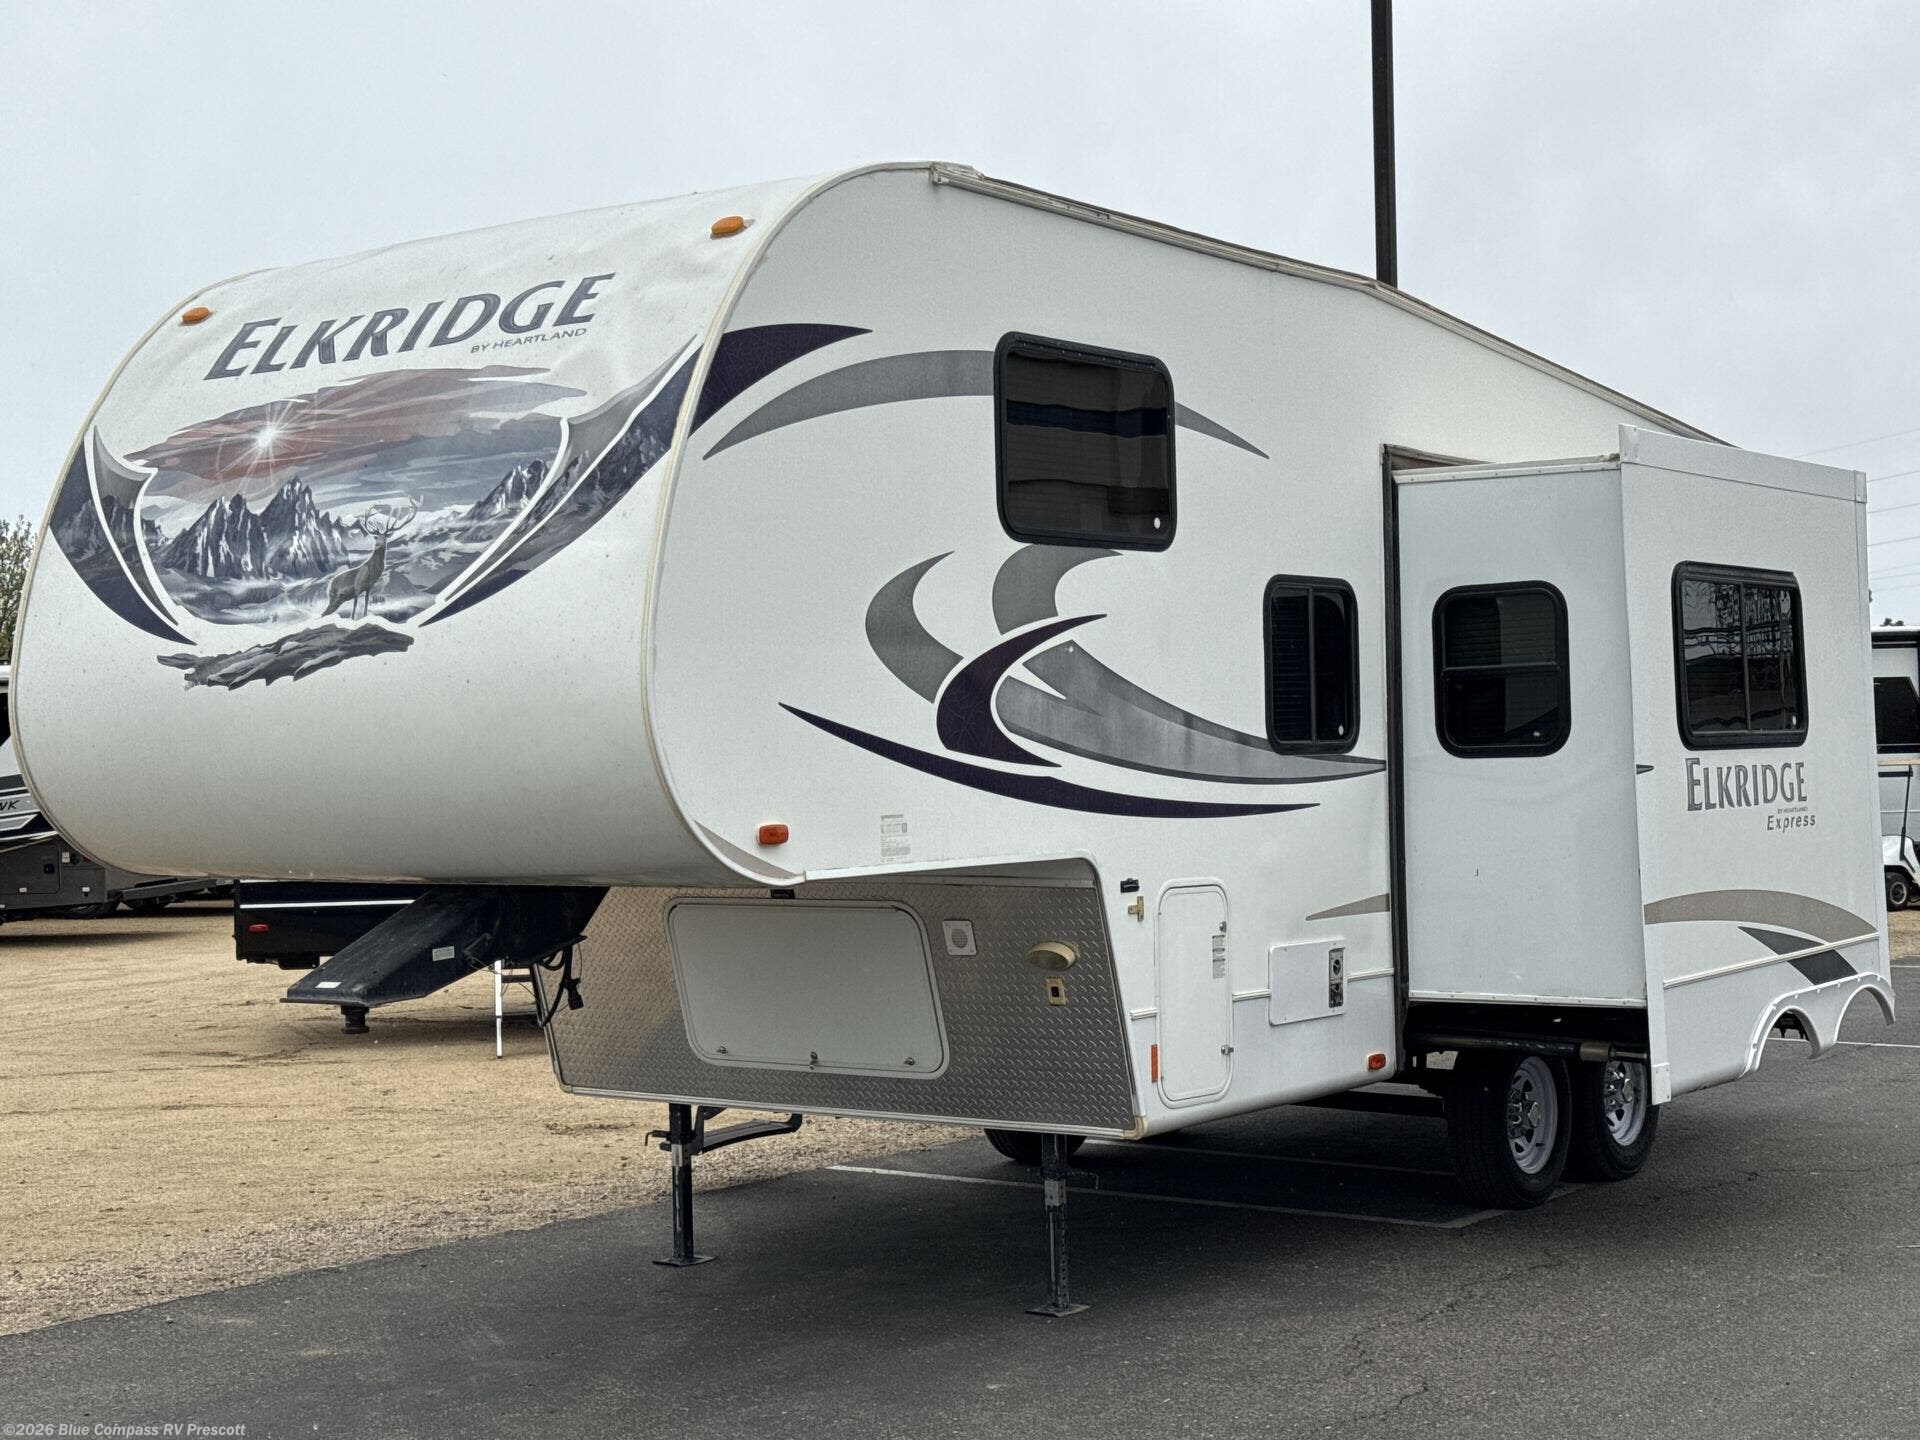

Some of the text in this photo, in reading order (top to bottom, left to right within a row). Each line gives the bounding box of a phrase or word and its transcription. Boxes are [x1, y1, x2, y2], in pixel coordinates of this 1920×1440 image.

[203, 272, 616, 381] ELKRIDGE
[470, 327, 588, 354] BY HEARTLAND
[1685, 757, 1808, 812] ELKRIDGE
[1766, 814, 1816, 833] Express
